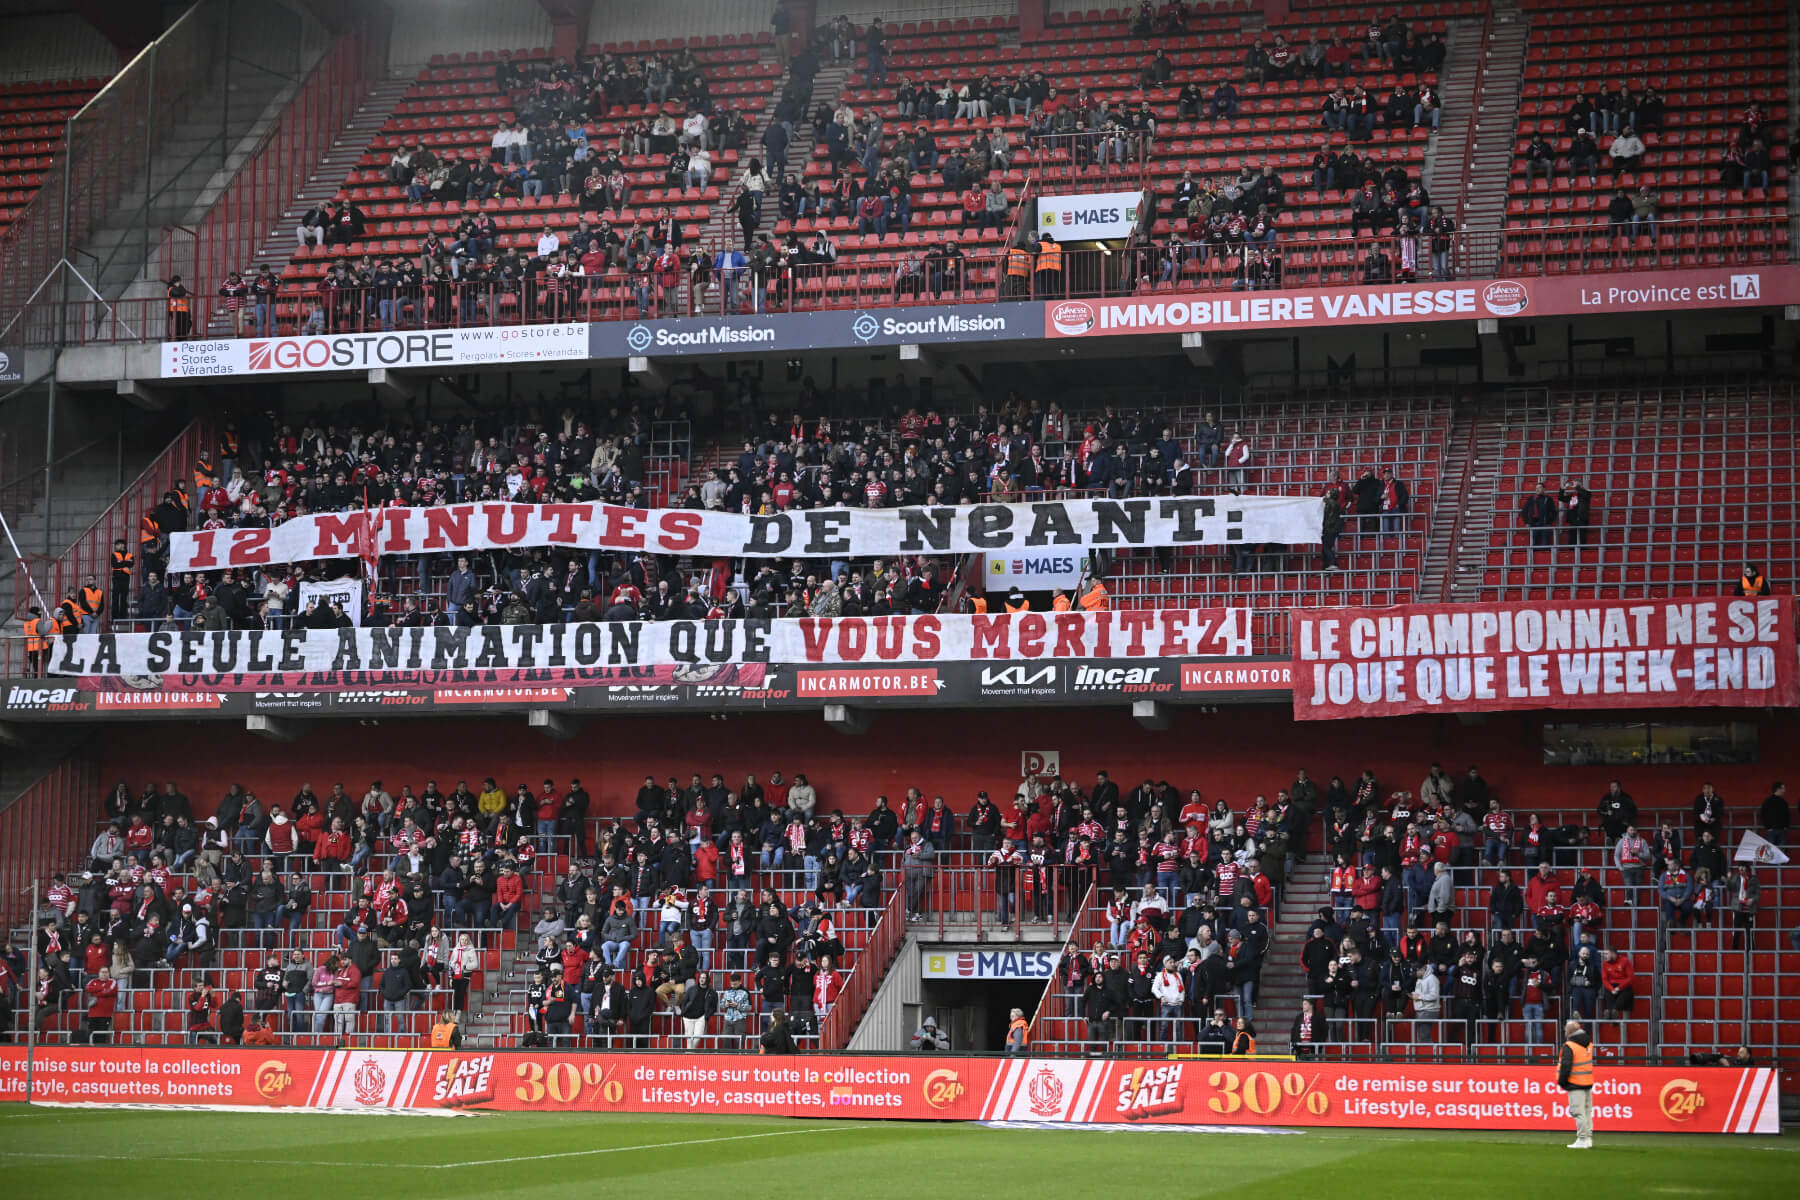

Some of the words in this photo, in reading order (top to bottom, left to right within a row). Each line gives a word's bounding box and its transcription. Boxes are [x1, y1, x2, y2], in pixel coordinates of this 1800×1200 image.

[1074, 208, 1120, 225] MAES
[1581, 289, 1601, 305] La
[1608, 285, 1691, 304] Province
[1697, 284, 1727, 300] est
[1733, 276, 1758, 298] LÀ
[1100, 296, 1314, 329] IMMOBILIERE
[1320, 288, 1476, 318] VANESSE
[460, 326, 584, 342] www.gostore.be
[181, 342, 230, 354] Pergolas
[274, 334, 453, 369] GOSTORE
[506, 350, 535, 359] Stores
[181, 354, 217, 365] Stores
[181, 364, 233, 375] Vérandas
[189, 528, 271, 567] 12
[313, 504, 703, 556] MINUTES
[742, 511, 851, 553] DE
[994, 563, 1001, 572] 4
[1025, 557, 1074, 574] MAES
[1300, 619, 1340, 660] LE
[1350, 605, 1655, 659] CHAMPIONNAT
[1665, 602, 1718, 645] NE
[1727, 599, 1779, 643] SE
[59, 634, 121, 673] LA
[147, 629, 307, 672] SEULE
[331, 622, 643, 670] ANIMATION
[669, 618, 772, 664] QUE
[799, 614, 942, 661] VOUS
[801, 675, 928, 691] INCARMOTOR.BE
[981, 665, 1056, 685] KIA
[1074, 665, 1160, 685] incar
[1311, 660, 1406, 706] JOUE
[1415, 656, 1496, 705] QUE
[1506, 654, 1550, 698] LE
[1558, 646, 1776, 695] WEEK-END
[7, 685, 79, 704] incar
[742, 689, 791, 700] motor
[1031, 687, 1056, 696] inspires
[1123, 681, 1174, 693] motor
[48, 701, 90, 711] motor
[100, 691, 213, 704] INCARMOTOR.BE
[381, 694, 427, 705] motor
[934, 960, 941, 969] 2
[977, 951, 1053, 976] MAES
[14, 1058, 67, 1072] remise
[70, 1060, 96, 1073] sur
[100, 1059, 141, 1073] toute
[145, 1059, 159, 1074] la
[162, 1059, 241, 1075] collection
[634, 1066, 655, 1081] de
[659, 1066, 718, 1082] remise
[721, 1070, 750, 1082] sur
[753, 1068, 800, 1082] toute
[804, 1068, 819, 1083] la
[824, 1068, 911, 1084] collection
[72, 1080, 164, 1097] casquettes,
[167, 1080, 233, 1096] bonnets
[262, 1071, 292, 1093] 24h
[433, 1072, 490, 1100] SALE
[515, 1062, 624, 1103] 30%
[1335, 1075, 1359, 1091] de
[1363, 1075, 1428, 1093] remise
[1431, 1079, 1464, 1093] sur
[1468, 1078, 1519, 1094] toute
[1523, 1078, 1540, 1094] la
[642, 1088, 719, 1107] Lifestyle,
[723, 1089, 826, 1108] casquettes,
[829, 1090, 902, 1107] bonnets
[931, 1082, 965, 1103] 24h
[1116, 1082, 1178, 1112] SALE
[1208, 1071, 1329, 1115] 30%
[1344, 1099, 1431, 1119] Lifestyle,
[1435, 1101, 1548, 1120] casquettes,
[1669, 1092, 1705, 1114] 24h
